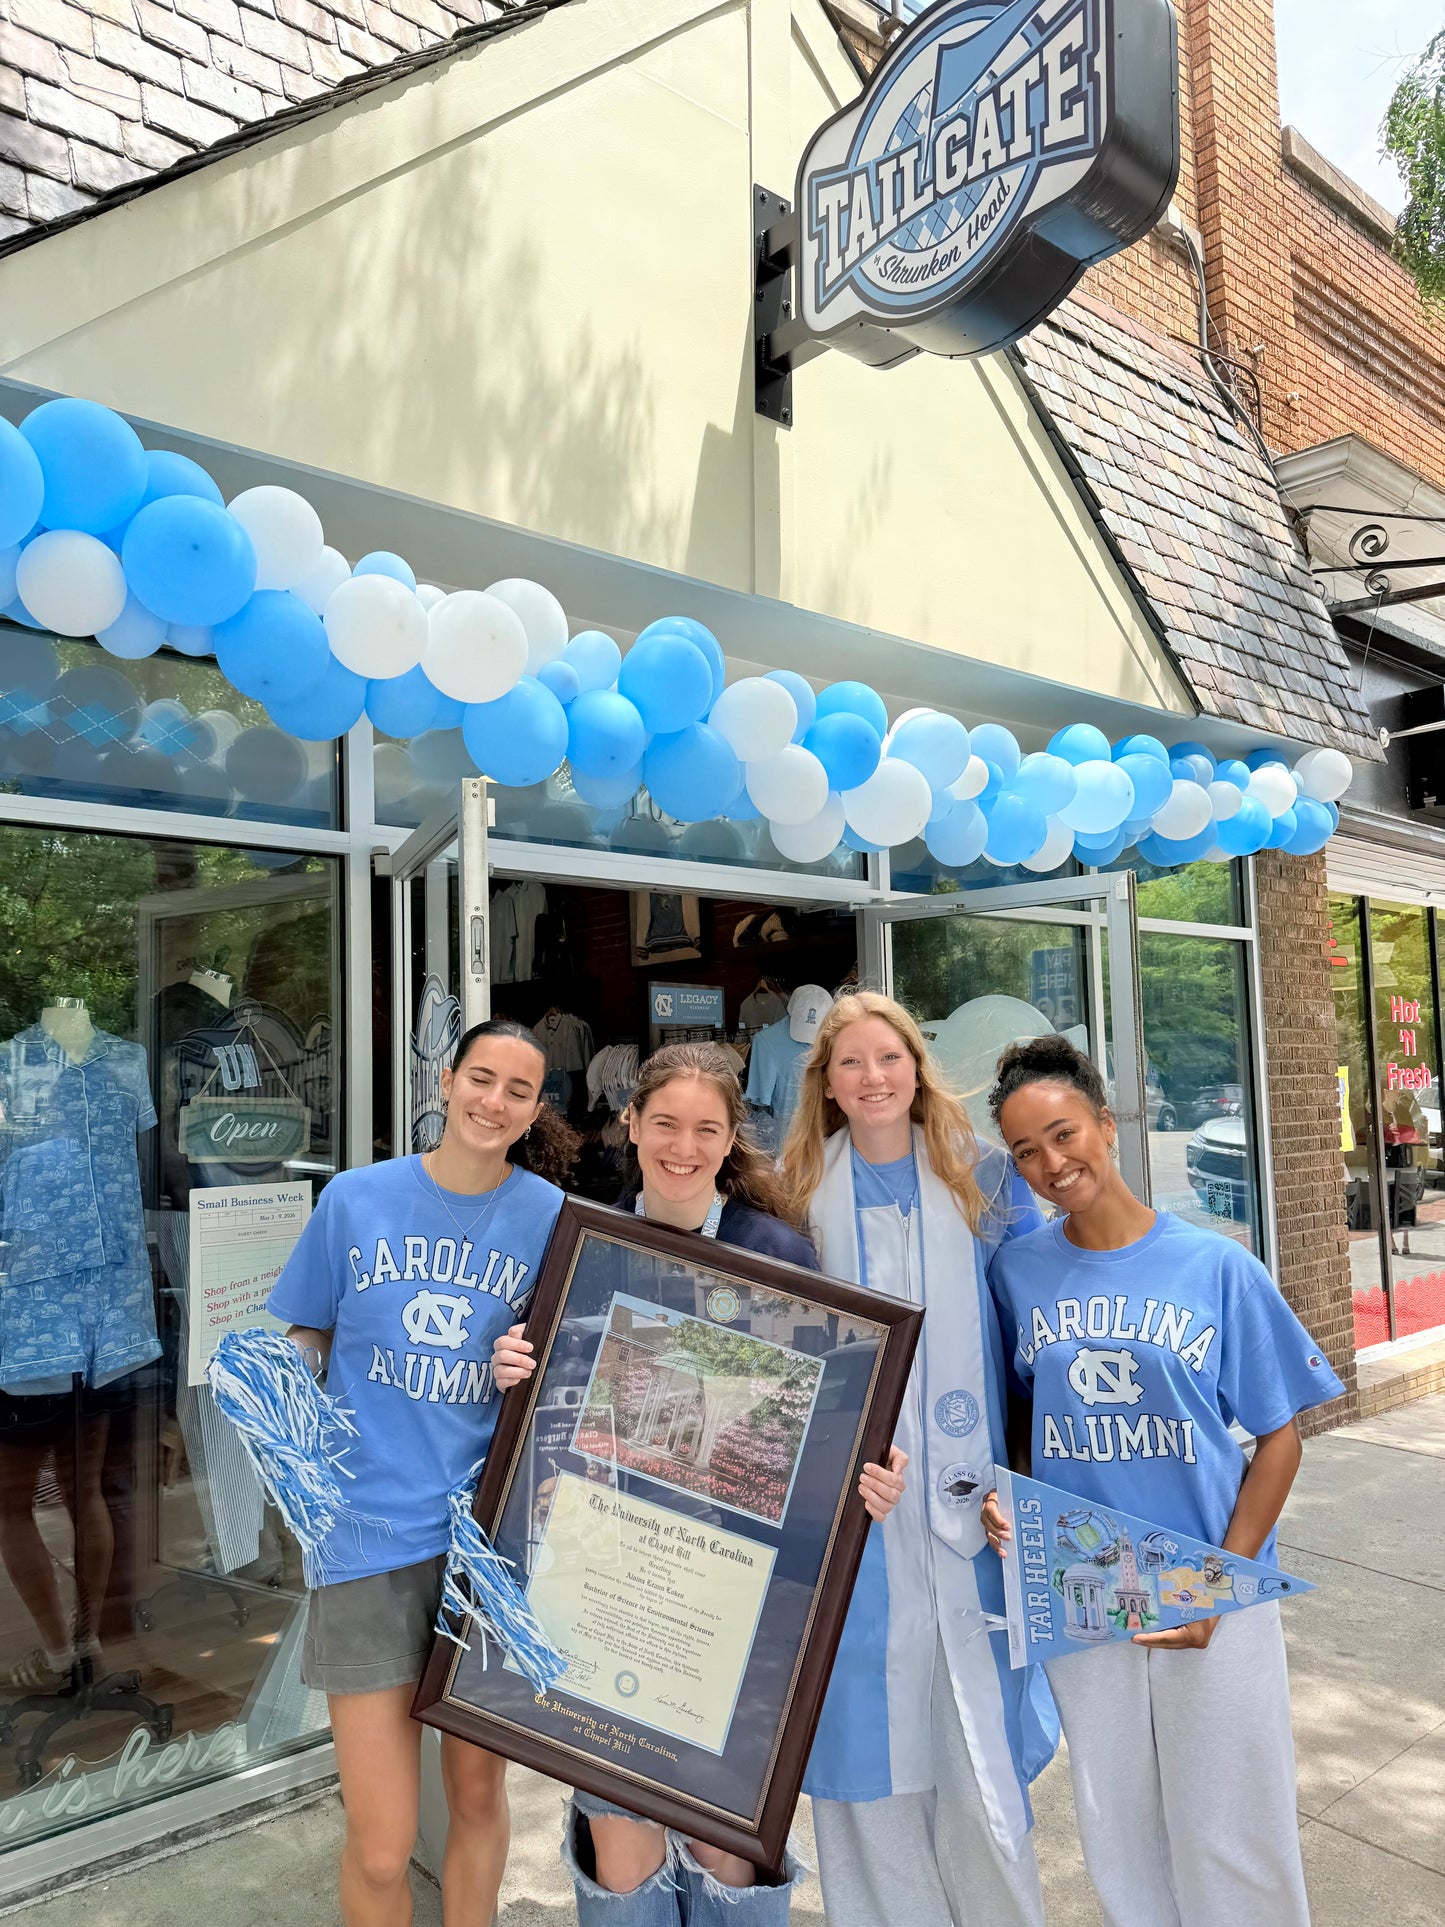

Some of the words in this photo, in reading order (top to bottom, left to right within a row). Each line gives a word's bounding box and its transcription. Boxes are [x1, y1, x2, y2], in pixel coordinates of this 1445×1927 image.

[817, 8, 1086, 288] TAILGATE
[878, 245, 962, 284] Shrunken
[966, 177, 1011, 250] Head
[679, 994, 719, 1005] LEGACY
[1390, 995, 1421, 1023] Hot
[1386, 1063, 1432, 1090] Fresh
[210, 1112, 282, 1147] Open
[197, 1199, 228, 1210] Small
[231, 1196, 274, 1207] Business
[277, 1192, 304, 1203] Week
[203, 1285, 227, 1299] Shop
[229, 1277, 251, 1291] from
[252, 1275, 259, 1283] a
[206, 1299, 230, 1313] Shop
[232, 1292, 251, 1305] with
[253, 1289, 259, 1297] a
[209, 1313, 233, 1327] Shop
[235, 1309, 244, 1318] in
[1041, 1413, 1198, 1465] ALUMNI
[944, 1471, 966, 1485] CLASS
[588, 1493, 610, 1513] The
[611, 1502, 661, 1535] University
[664, 1523, 675, 1537] of
[676, 1526, 706, 1549] North
[709, 1539, 754, 1566] Carolina
[1018, 1498, 1049, 1586] HEELS
[639, 1534, 646, 1544] at
[648, 1536, 674, 1556] Chapel
[676, 1547, 690, 1560] Hill
[1026, 1590, 1055, 1645] TAR
[572, 1723, 582, 1734] at
[583, 1728, 610, 1747] Chapel
[613, 1739, 631, 1755] Hill
[113, 1727, 240, 1799] here
